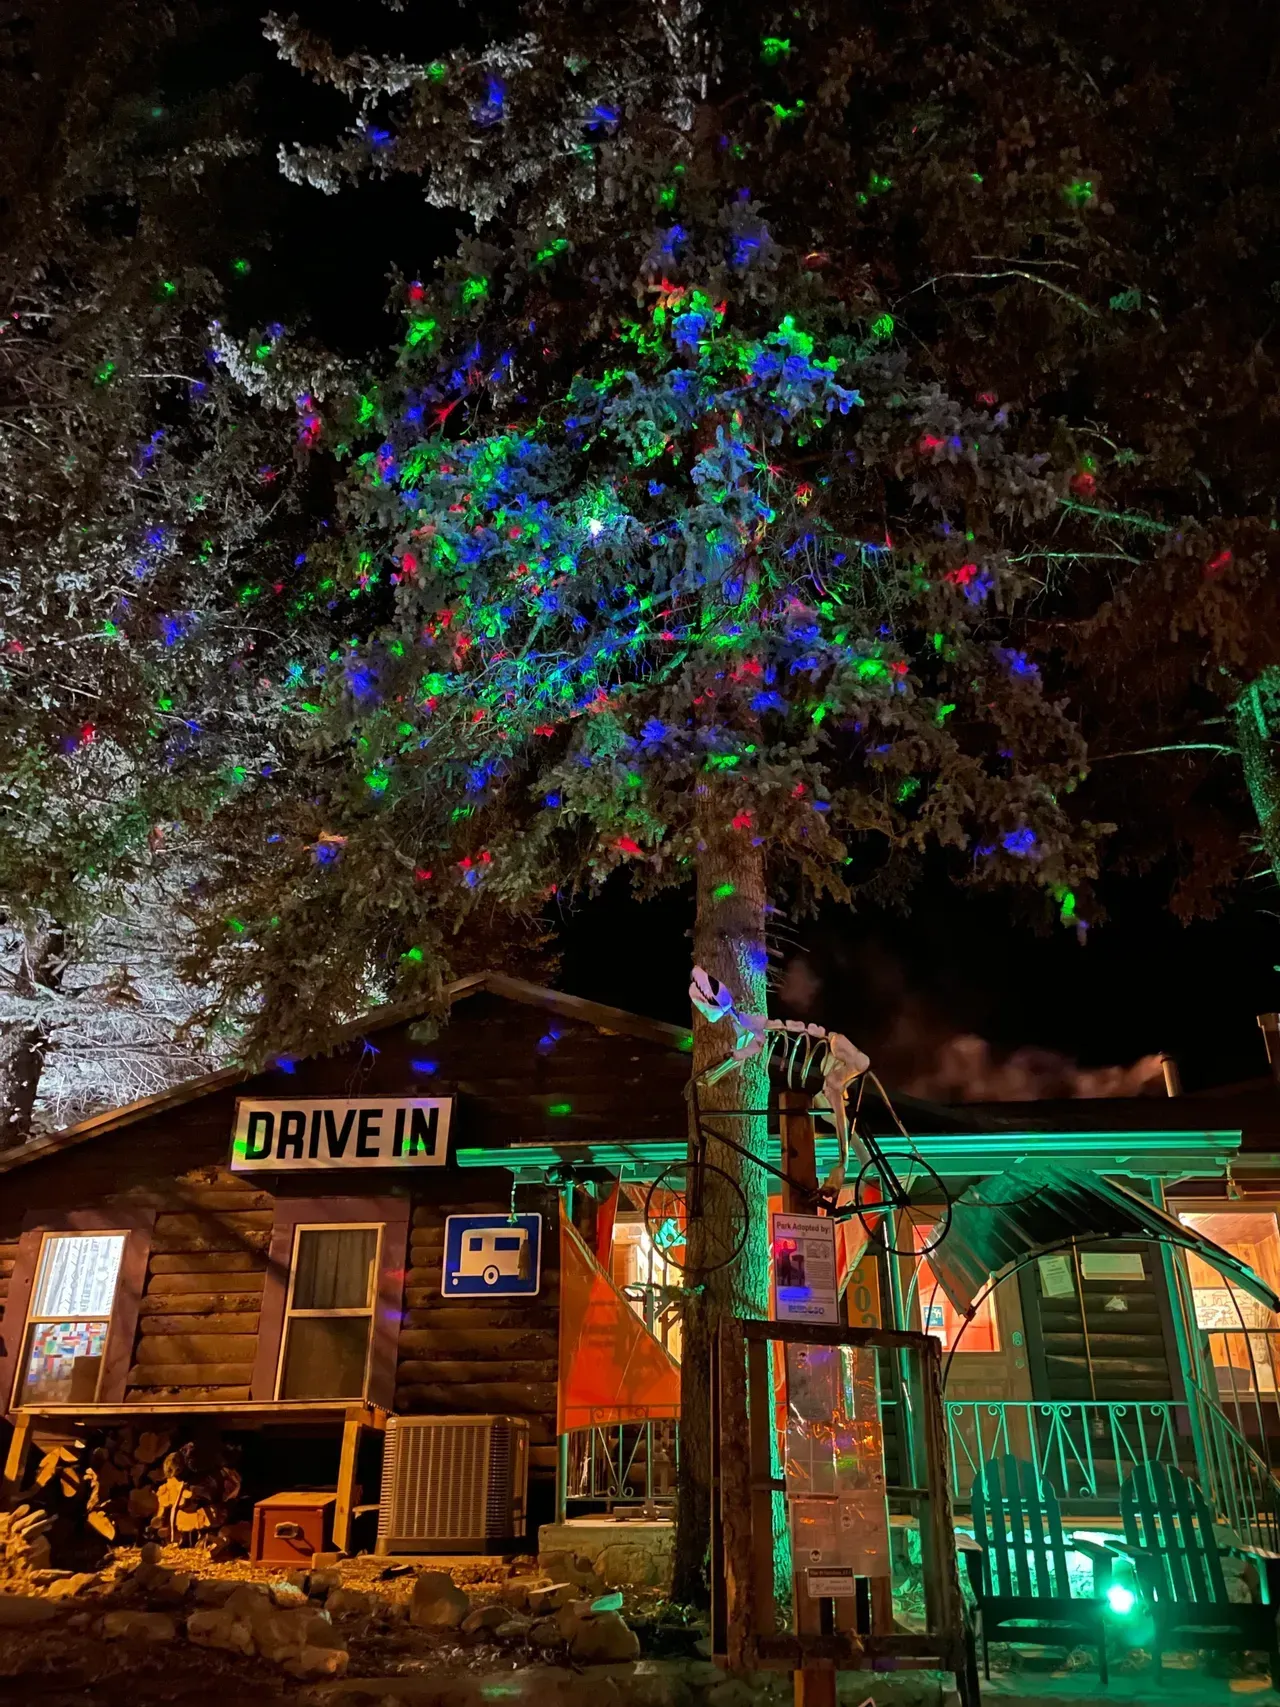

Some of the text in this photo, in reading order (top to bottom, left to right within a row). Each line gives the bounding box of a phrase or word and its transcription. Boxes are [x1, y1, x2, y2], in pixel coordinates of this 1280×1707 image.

[245, 1107, 439, 1160] DRIVE IN
[777, 1221, 791, 1230] Park
[792, 1222, 819, 1233] Adopted
